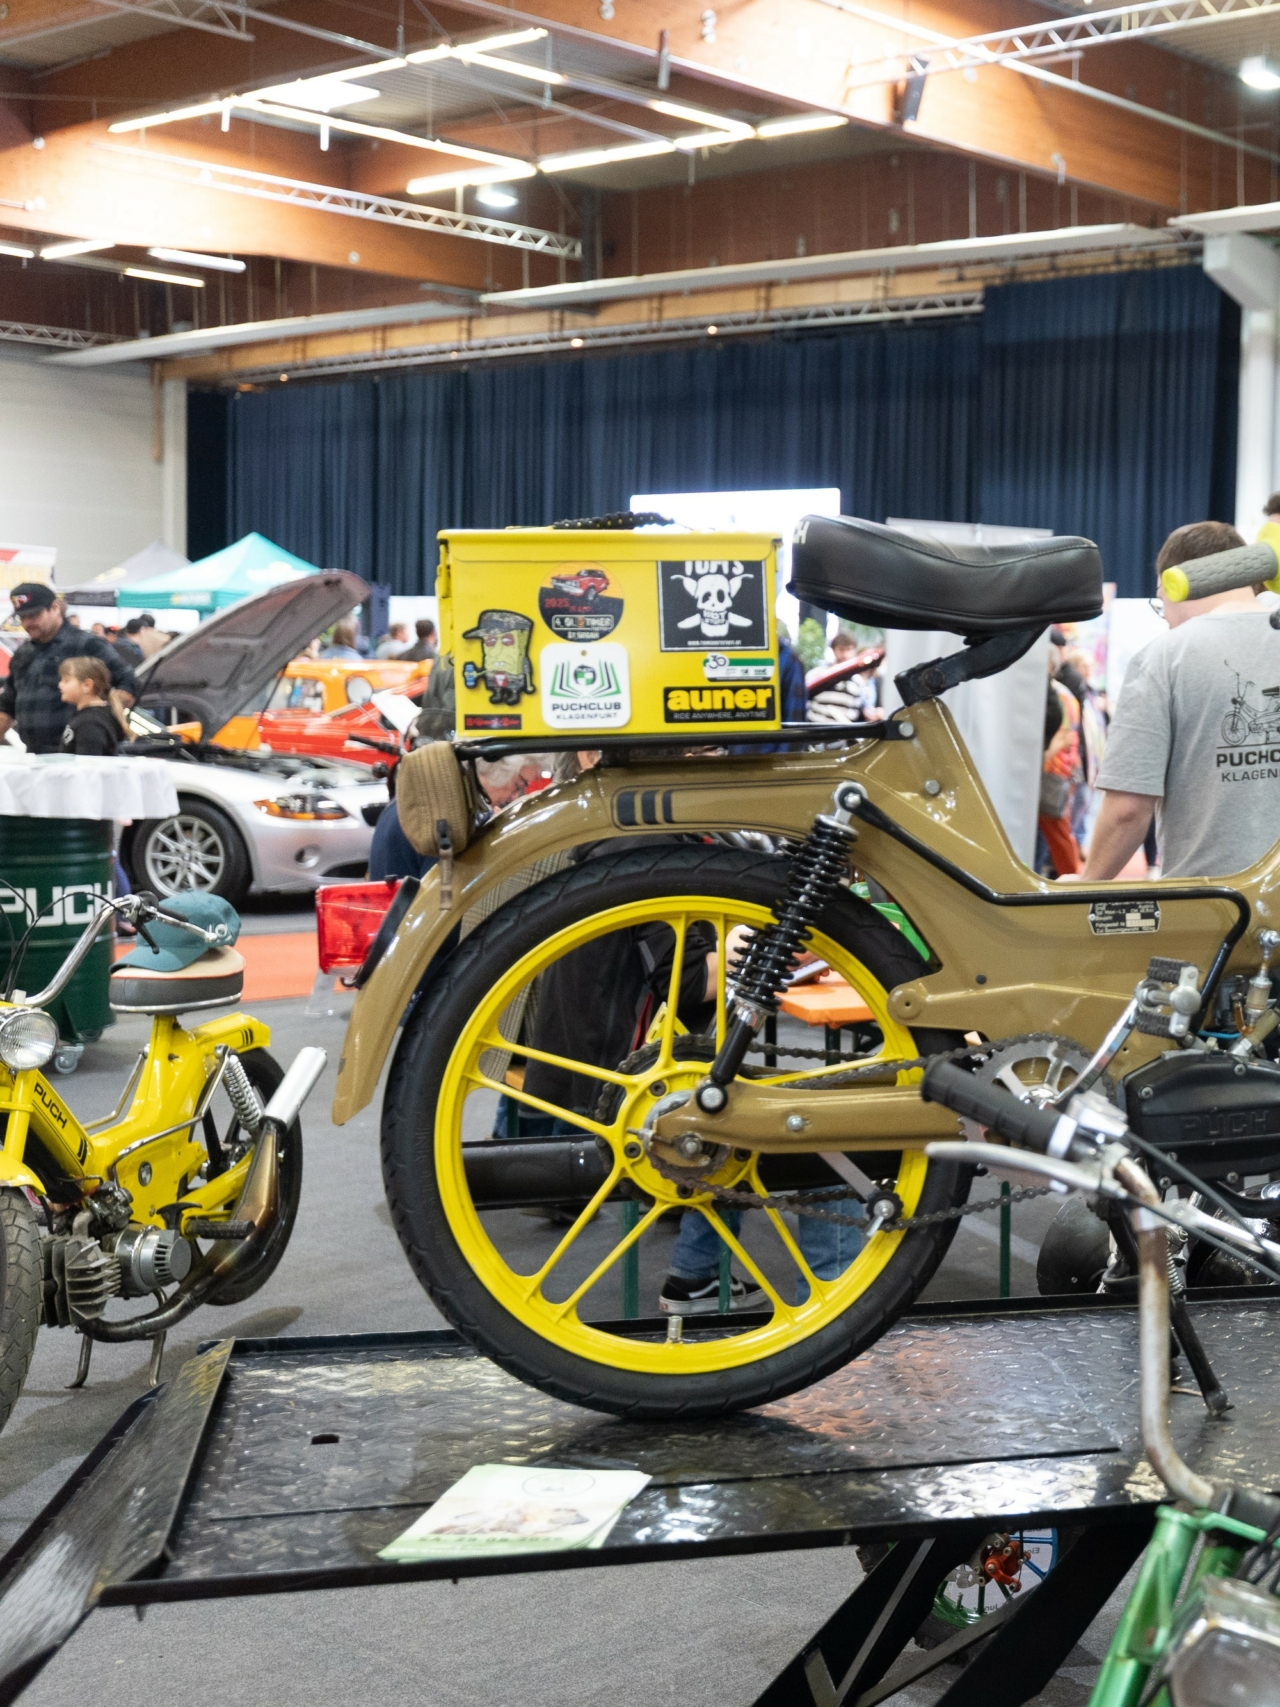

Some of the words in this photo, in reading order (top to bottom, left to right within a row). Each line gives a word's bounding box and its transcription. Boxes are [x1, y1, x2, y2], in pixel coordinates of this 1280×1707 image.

[708, 655, 727, 670] 30
[552, 702, 622, 712] PUCHCLUB
[666, 688, 772, 711] auner
[556, 712, 618, 720] KLAGENFURT
[734, 710, 768, 719] ANYTIME
[33, 1082, 68, 1129] PUCH
[1178, 1109, 1271, 1141] PUCH
